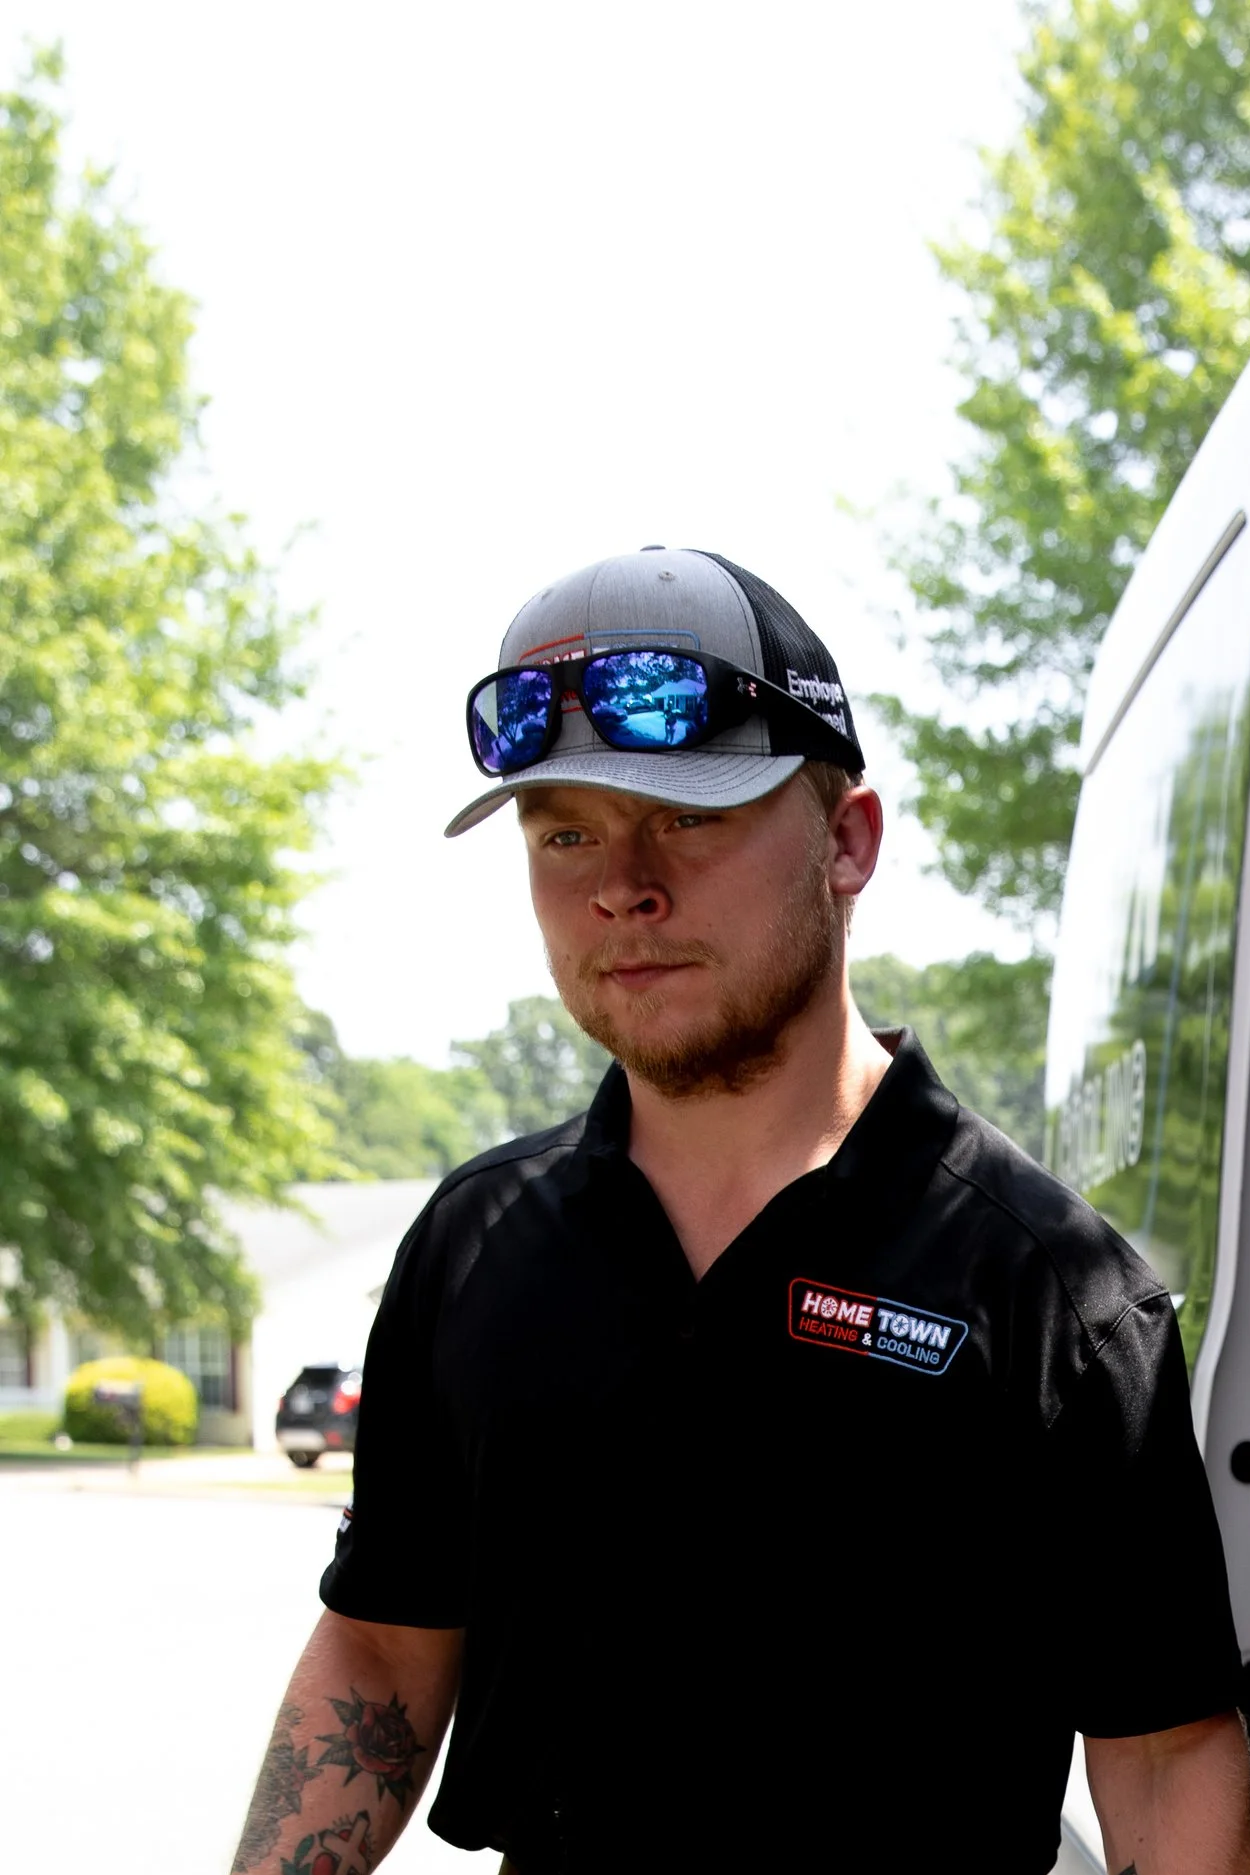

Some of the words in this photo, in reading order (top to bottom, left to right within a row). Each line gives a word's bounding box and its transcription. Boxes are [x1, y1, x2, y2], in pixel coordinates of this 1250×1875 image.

[800, 1316, 859, 1342] HEATING
[861, 1332, 873, 1347] &
[876, 1336, 941, 1365] COOLING
[801, 1290, 874, 1328] HOME
[877, 1307, 952, 1349] TOWN
